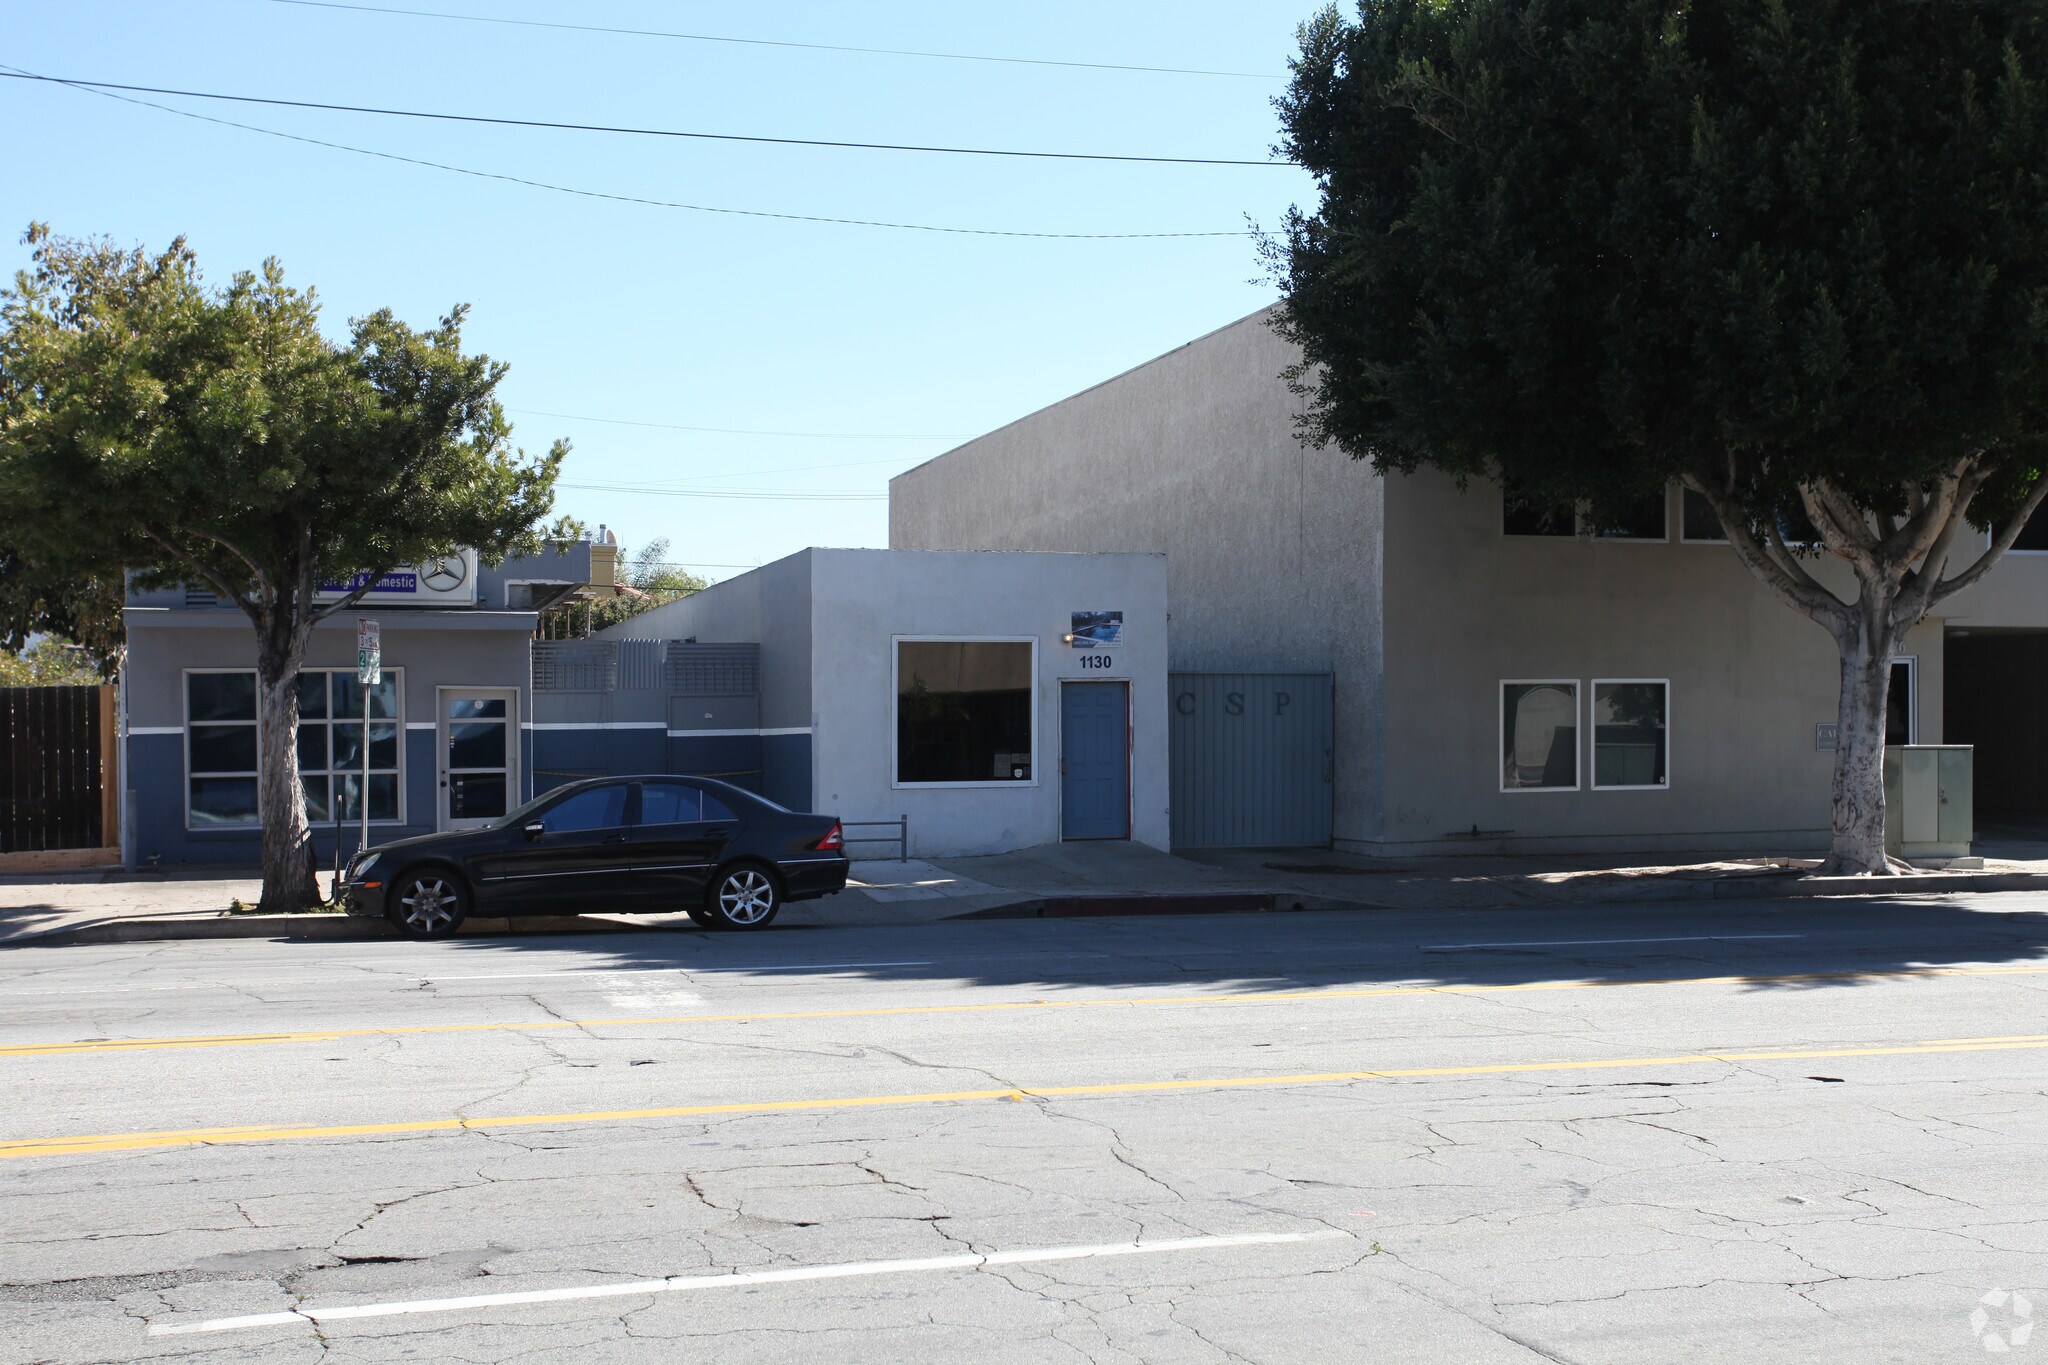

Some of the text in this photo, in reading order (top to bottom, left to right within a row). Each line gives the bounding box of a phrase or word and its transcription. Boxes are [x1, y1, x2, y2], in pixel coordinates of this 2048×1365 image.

[358, 575, 365, 587] &
[369, 575, 415, 588] omestic
[1080, 655, 1112, 669] 1130
[1176, 692, 1291, 715] C S P
